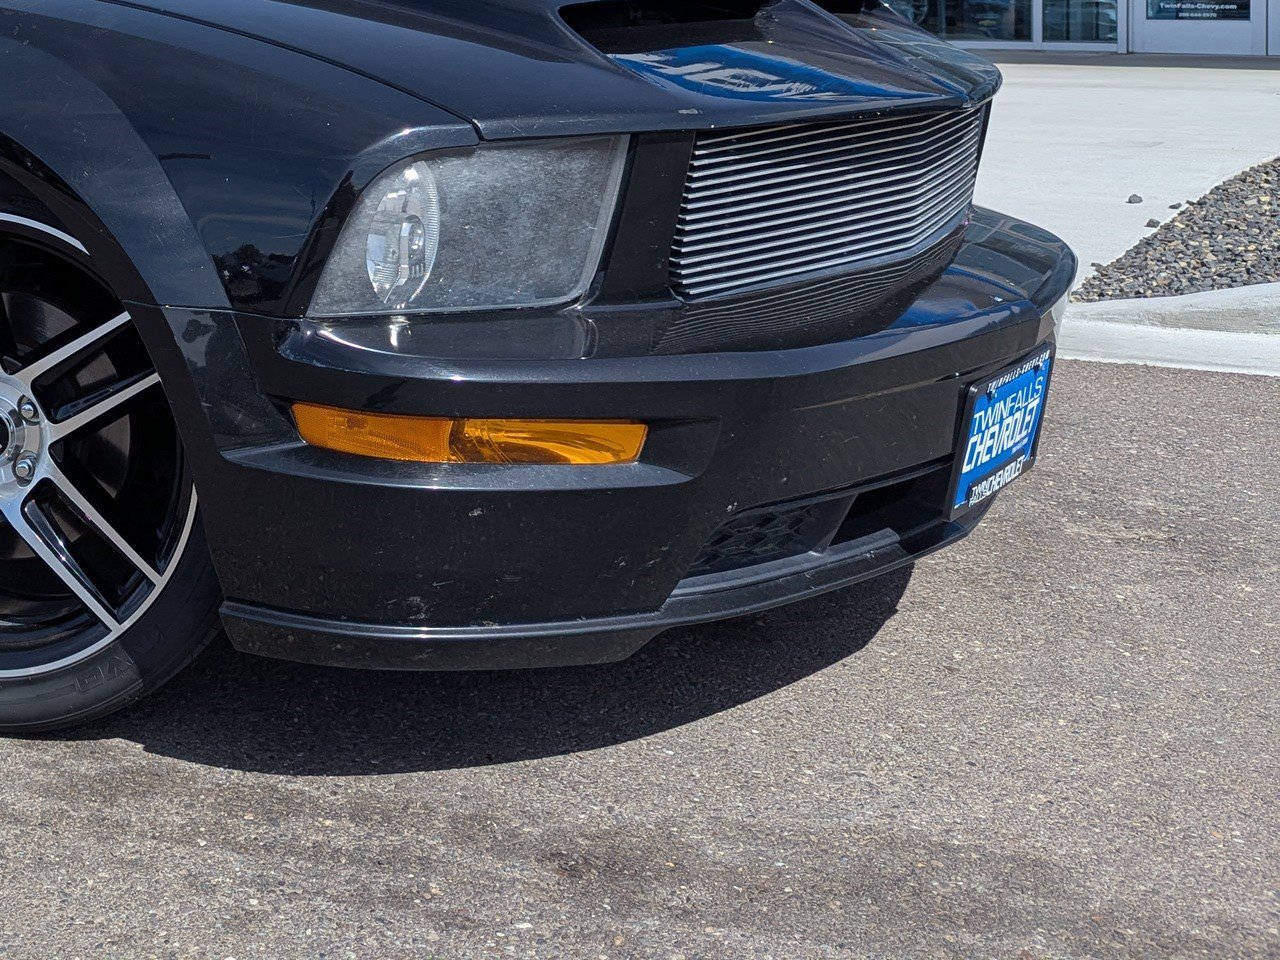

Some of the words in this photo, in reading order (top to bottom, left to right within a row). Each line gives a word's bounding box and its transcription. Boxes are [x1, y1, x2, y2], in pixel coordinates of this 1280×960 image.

[974, 376, 1043, 435] TWINFALLS
[962, 398, 1040, 473] CHEVROLET
[984, 454, 1025, 498] CHEVROLET
